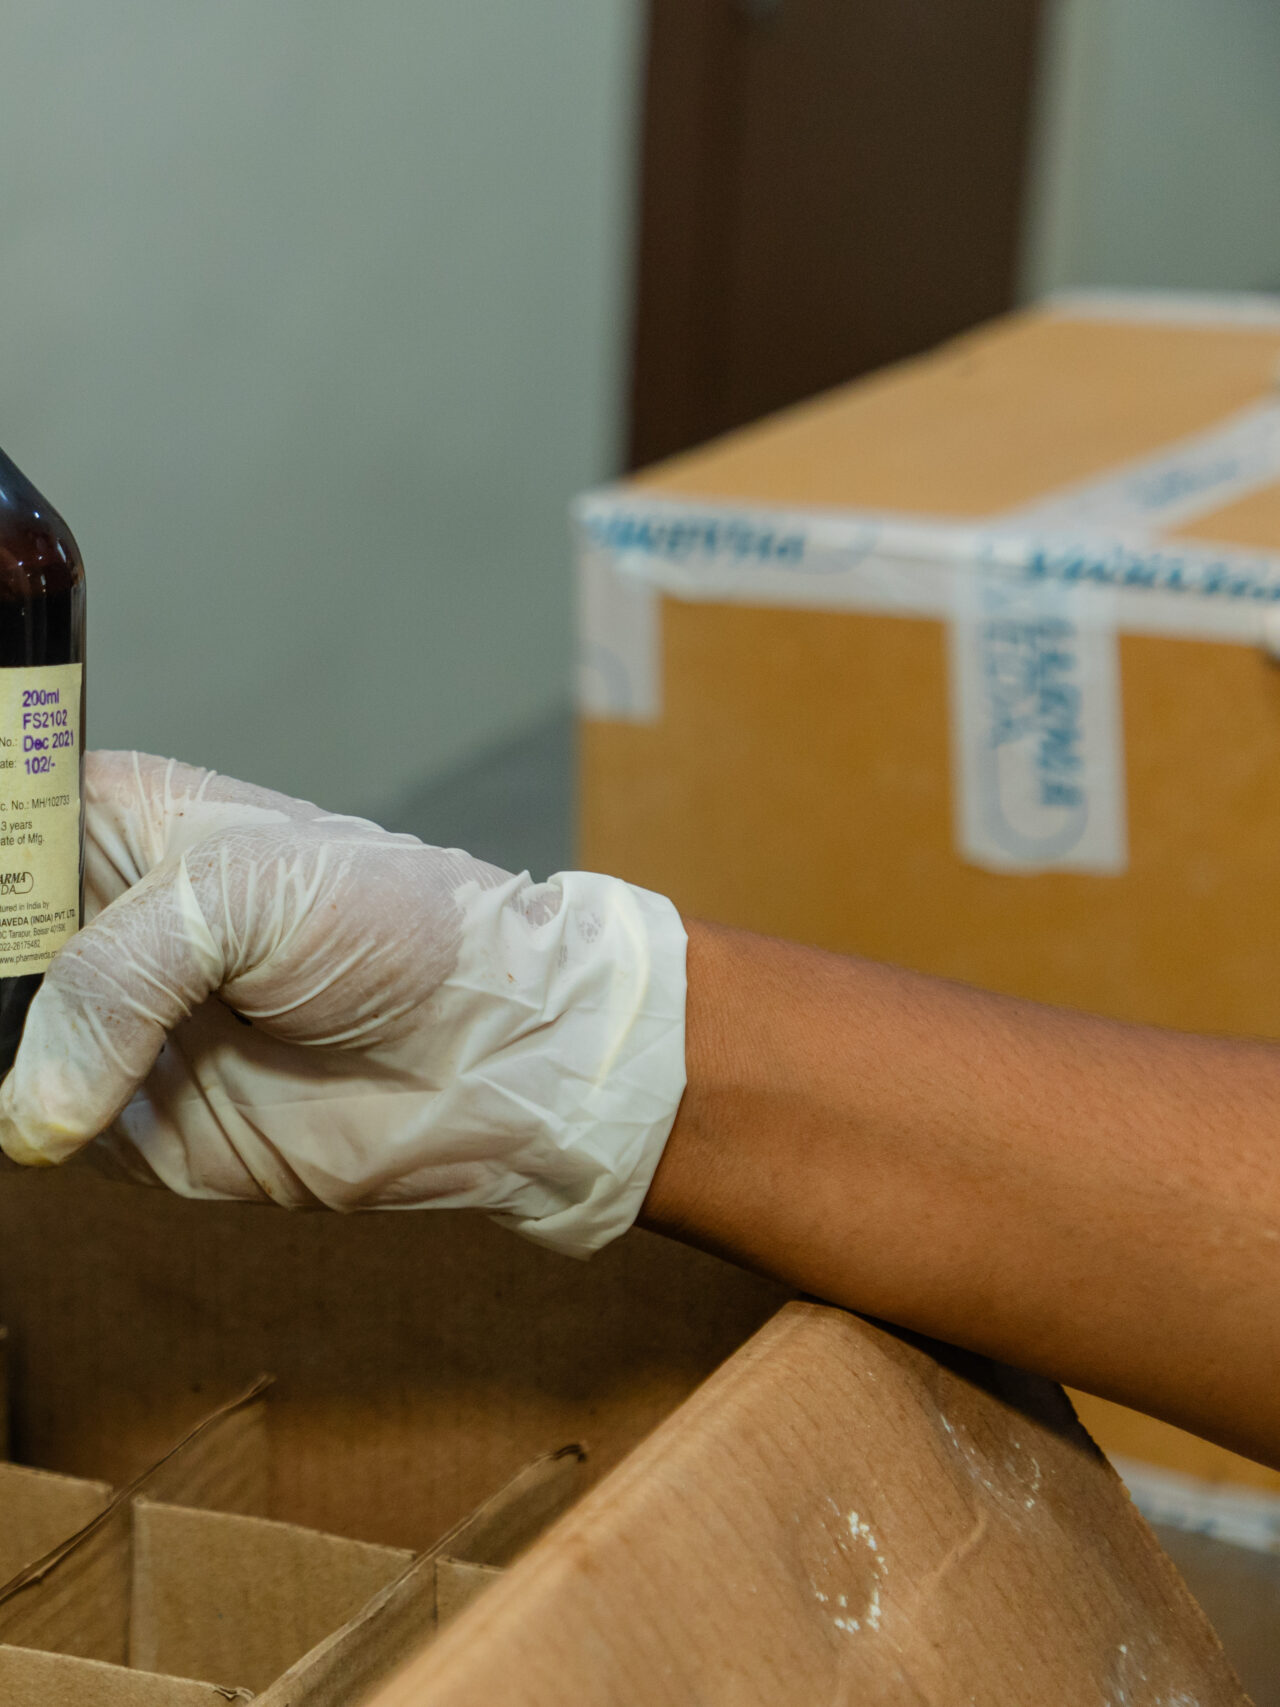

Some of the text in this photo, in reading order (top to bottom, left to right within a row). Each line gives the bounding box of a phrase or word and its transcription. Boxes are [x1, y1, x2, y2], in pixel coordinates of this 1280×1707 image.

[22, 688, 60, 708] 200ml
[23, 709, 68, 730] FS2102
[23, 729, 74, 752] Dec 2021
[24, 755, 56, 775] 102/-
[0, 821, 7, 831] 3
[9, 821, 32, 833] years
[17, 834, 25, 845] of
[30, 913, 53, 927] (INDIA)
